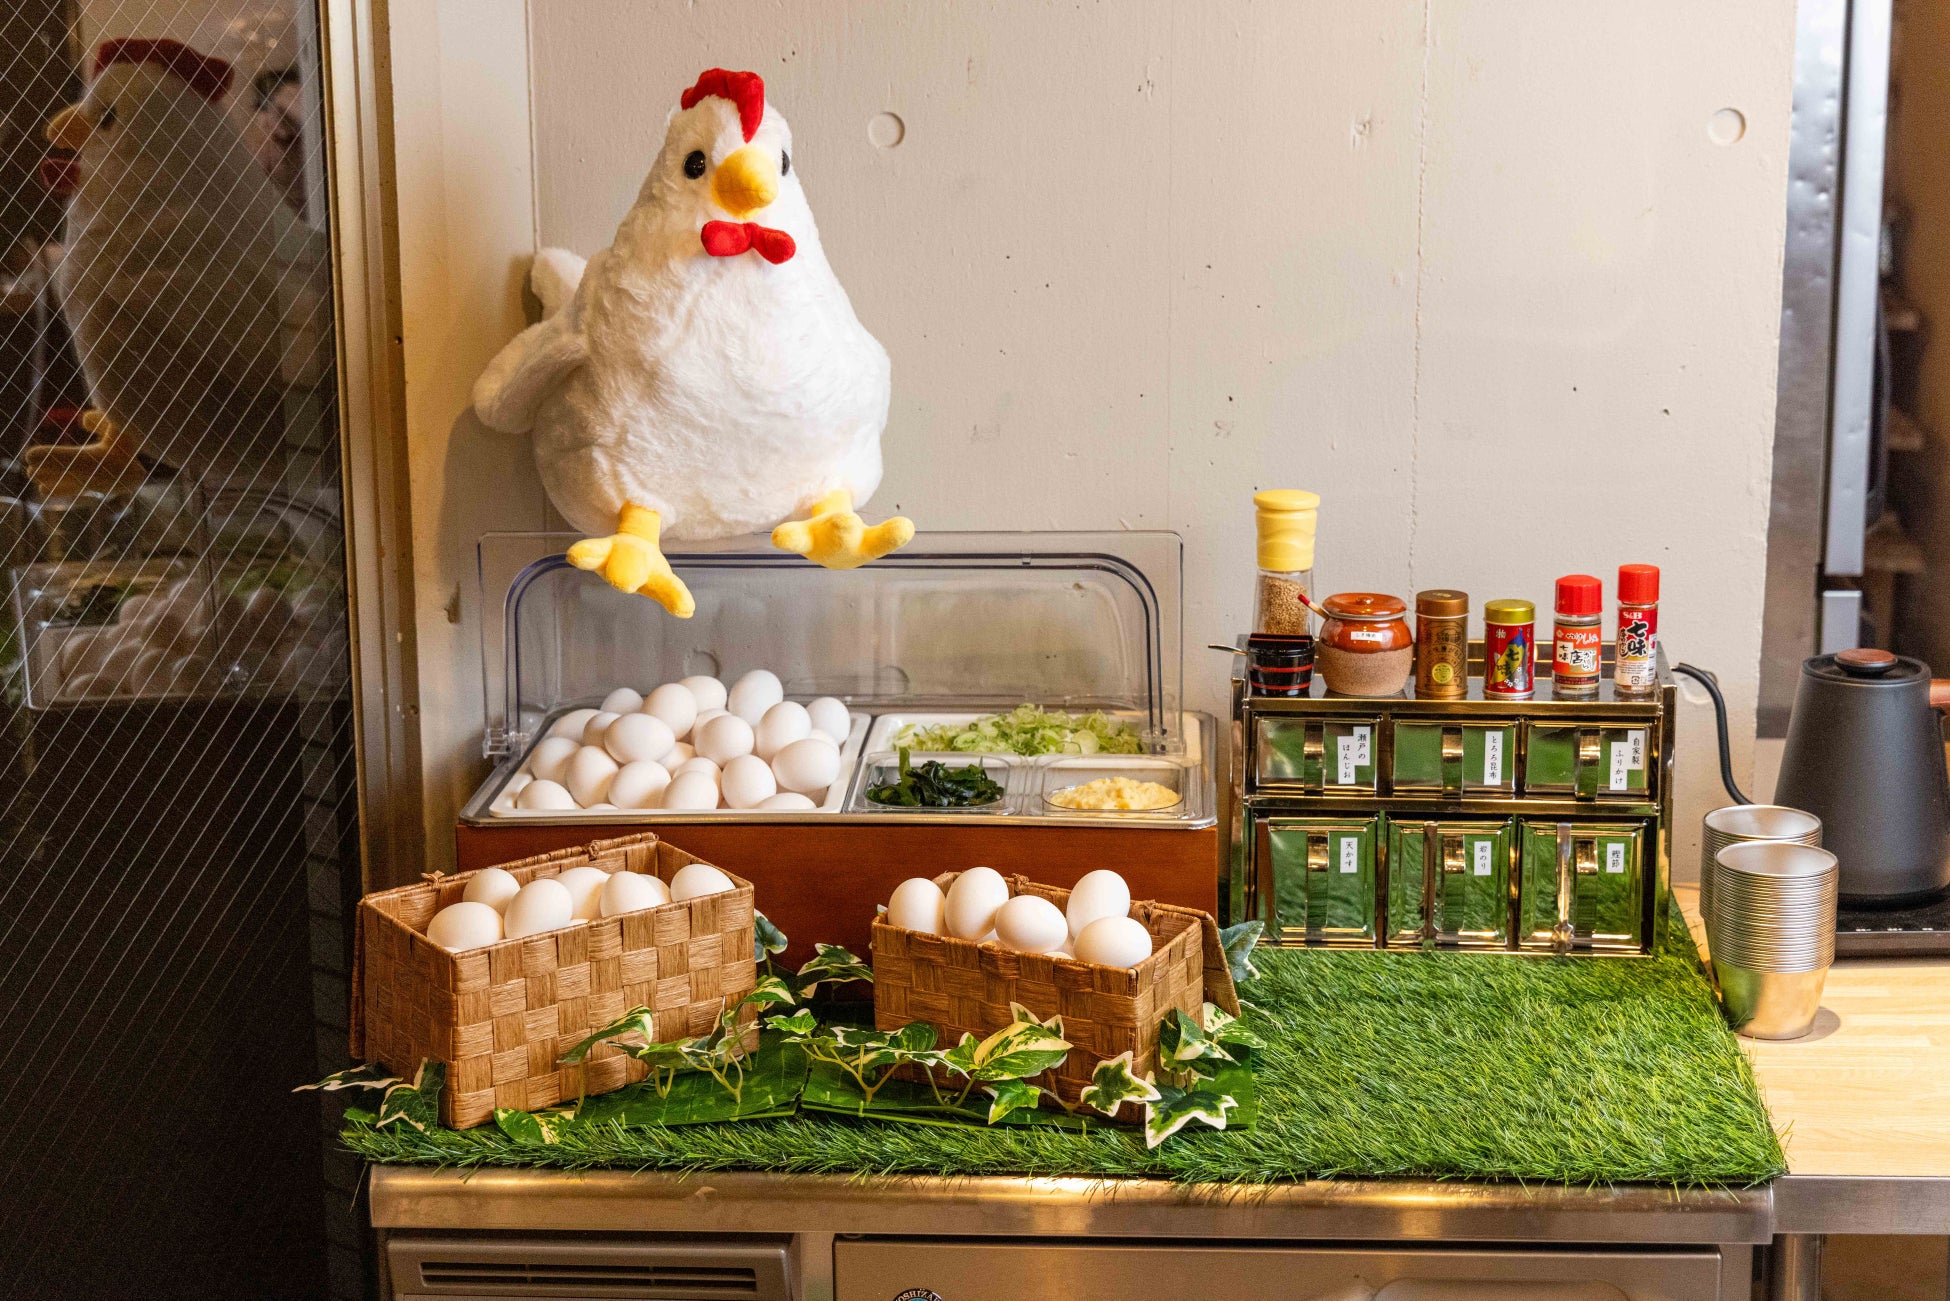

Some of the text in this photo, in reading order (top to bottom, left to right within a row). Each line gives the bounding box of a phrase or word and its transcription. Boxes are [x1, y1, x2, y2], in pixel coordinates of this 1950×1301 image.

[1627, 621, 1648, 656] 七味
[1559, 644, 1569, 661] 七味
[1357, 733, 1367, 760] 瀬戸の
[1488, 735, 1498, 780] とろろ昆布
[1632, 737, 1640, 765] 自家製
[1342, 744, 1351, 779] ほんじお
[1615, 750, 1624, 784] ふりかけ
[1344, 841, 1354, 868] 天かす
[1479, 845, 1487, 870] 岩のり
[896, 1291, 940, 1301] OSHIZA
